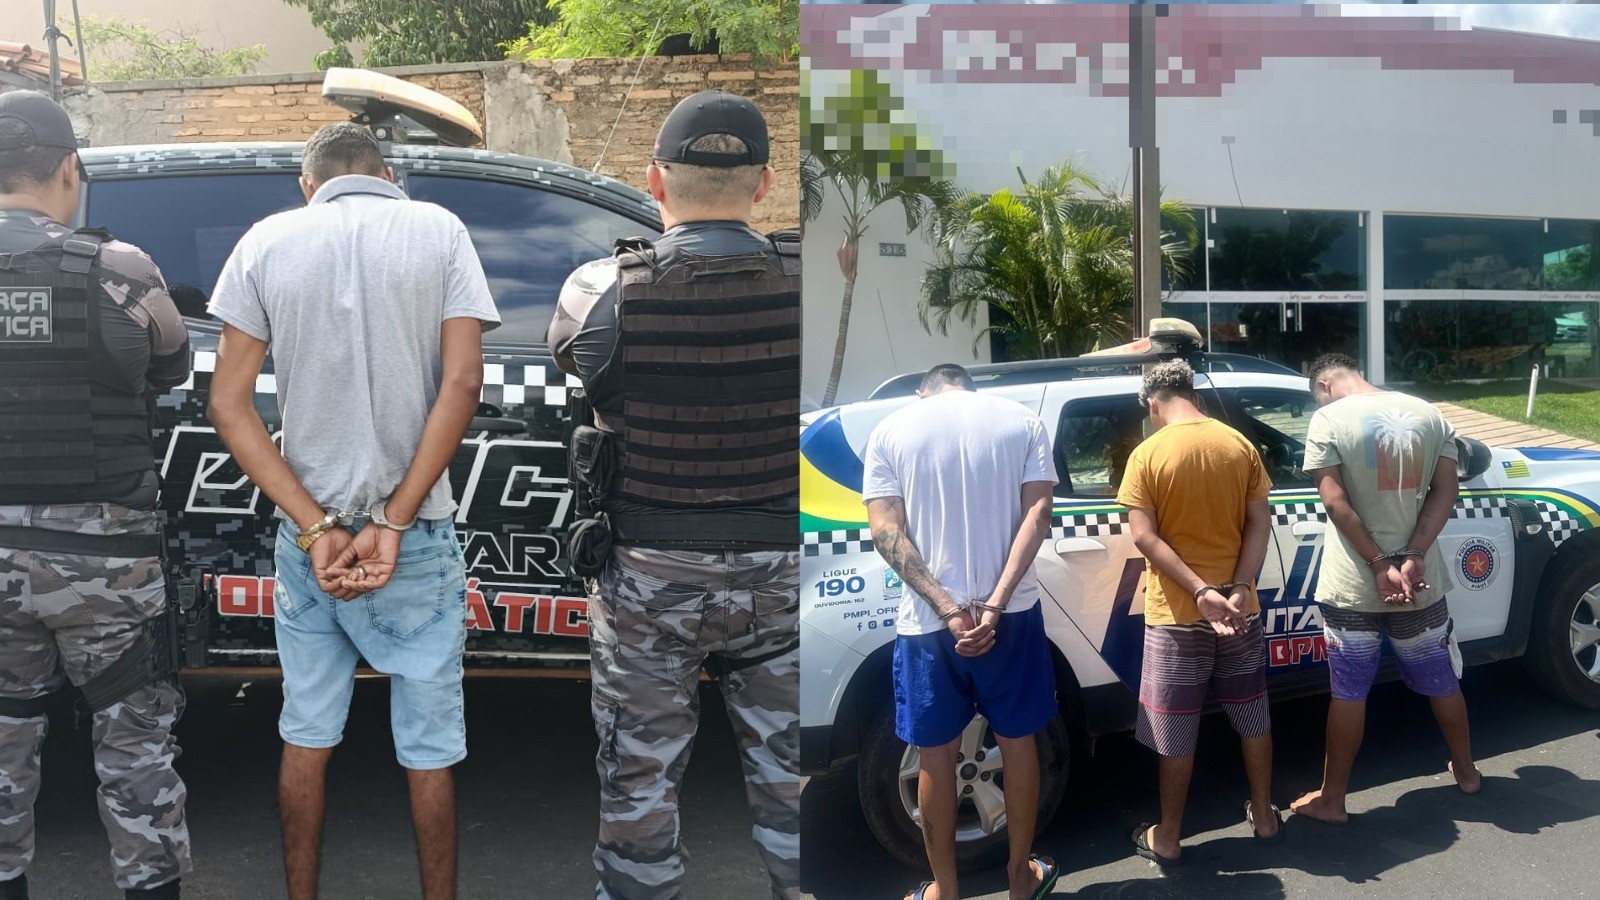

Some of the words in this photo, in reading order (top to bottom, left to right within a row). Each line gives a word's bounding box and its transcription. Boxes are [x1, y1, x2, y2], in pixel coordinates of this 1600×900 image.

[0, 316, 50, 338] ICA
[1476, 539, 1496, 553] MILITAR
[823, 567, 858, 578] LIGUE
[814, 576, 865, 598] 190
[814, 599, 853, 608] OUVIDORIA:
